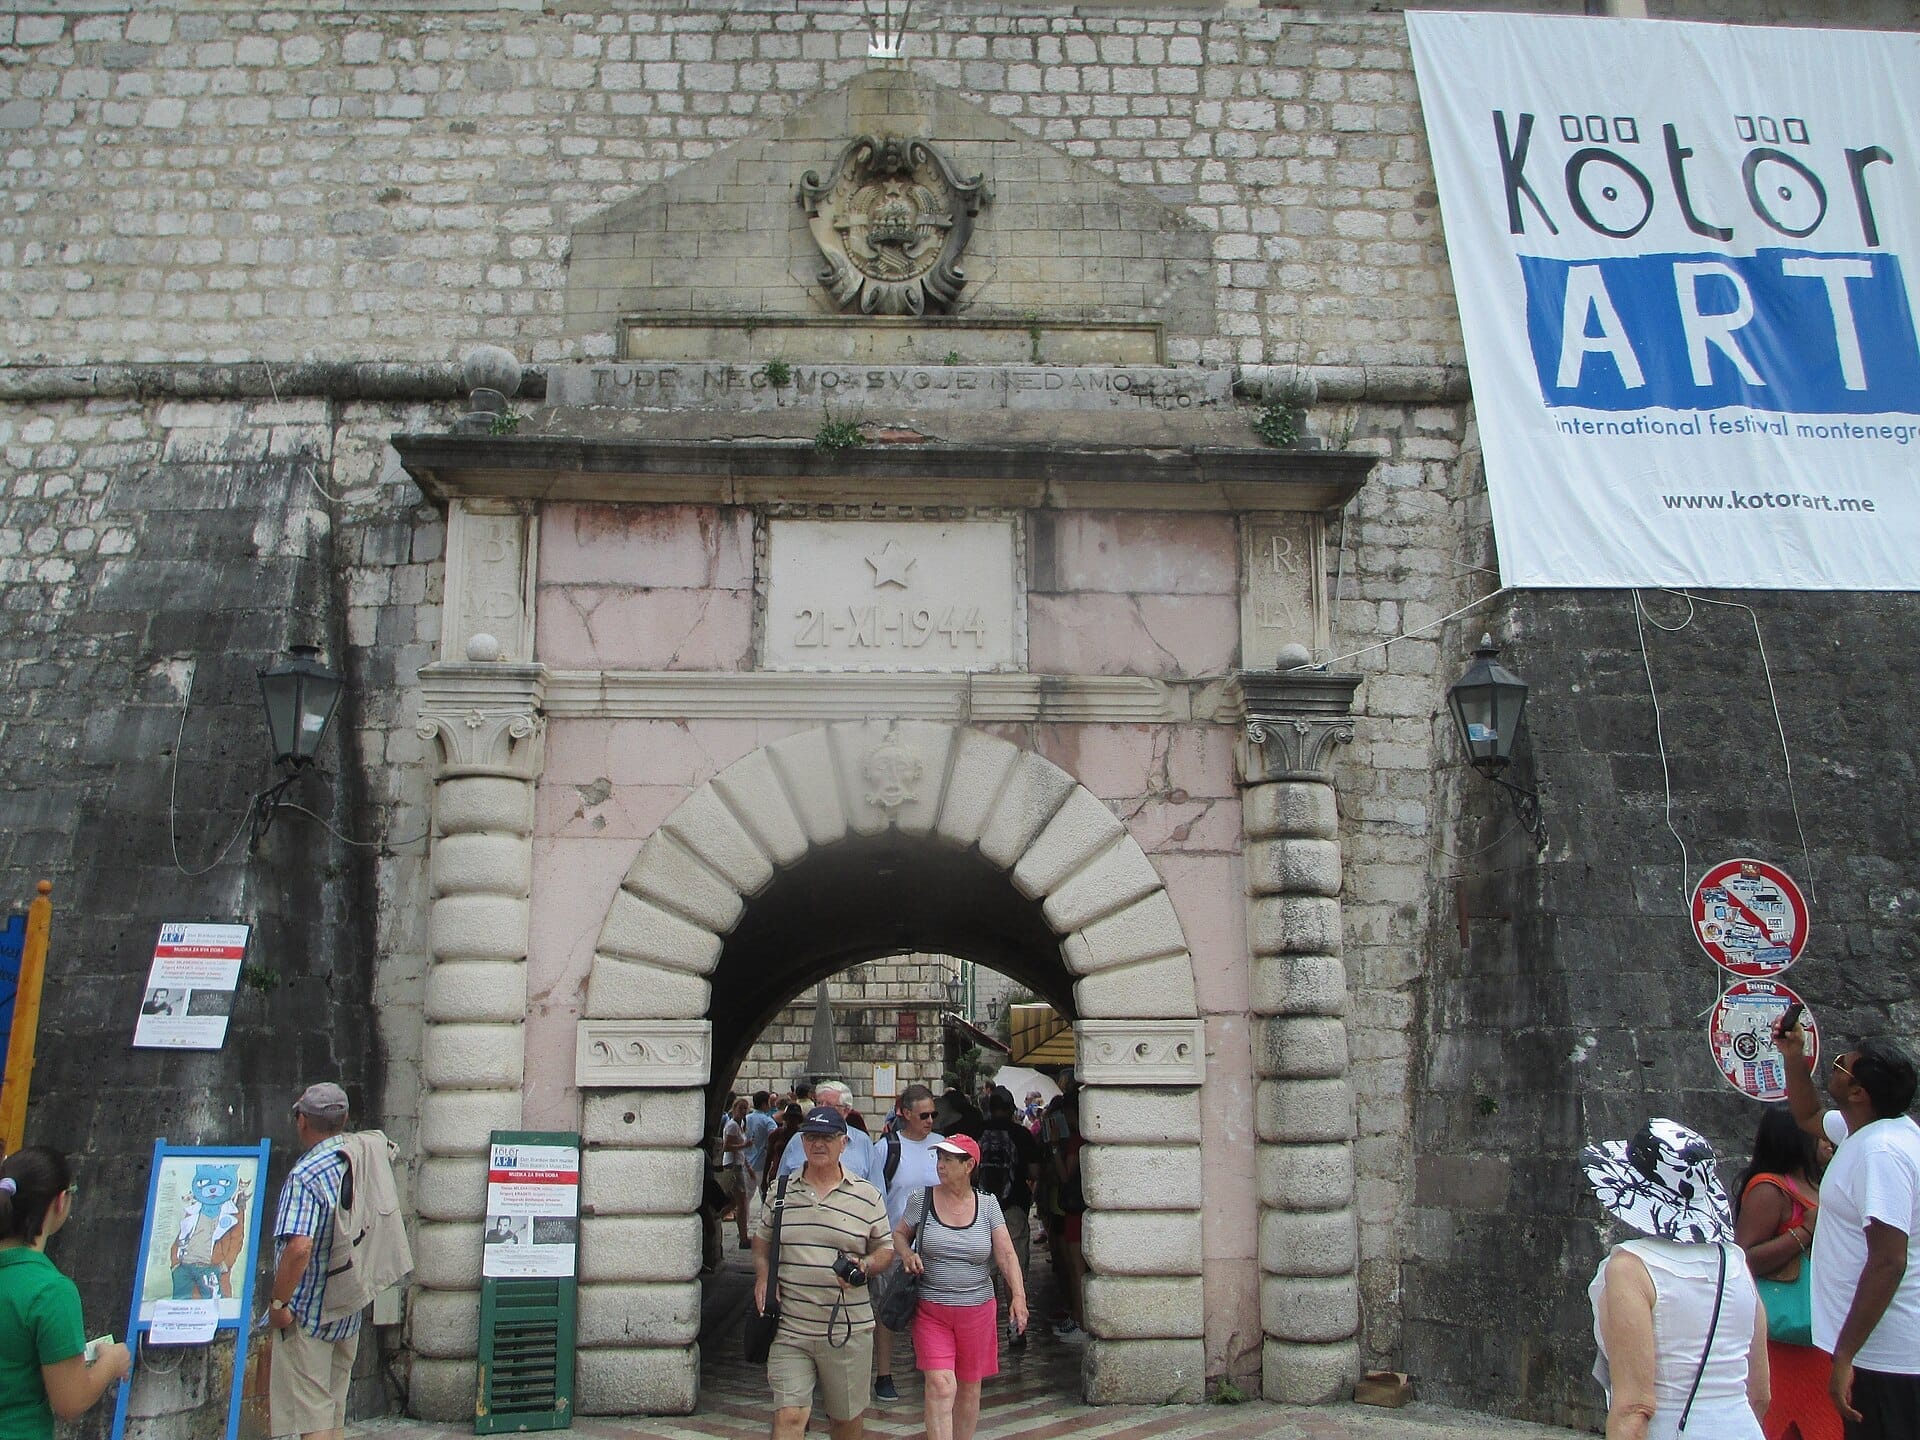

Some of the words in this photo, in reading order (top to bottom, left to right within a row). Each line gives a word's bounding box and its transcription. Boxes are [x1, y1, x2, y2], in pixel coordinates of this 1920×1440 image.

[1555, 257, 1873, 391] ART
[1554, 414, 1702, 436] international
[1709, 414, 1789, 437] festival
[1796, 420, 1920, 444] montenegr
[1662, 491, 1876, 513] www.kotorart.me
[1271, 535, 1297, 573] R
[794, 605, 985, 648] 21-XI-1944
